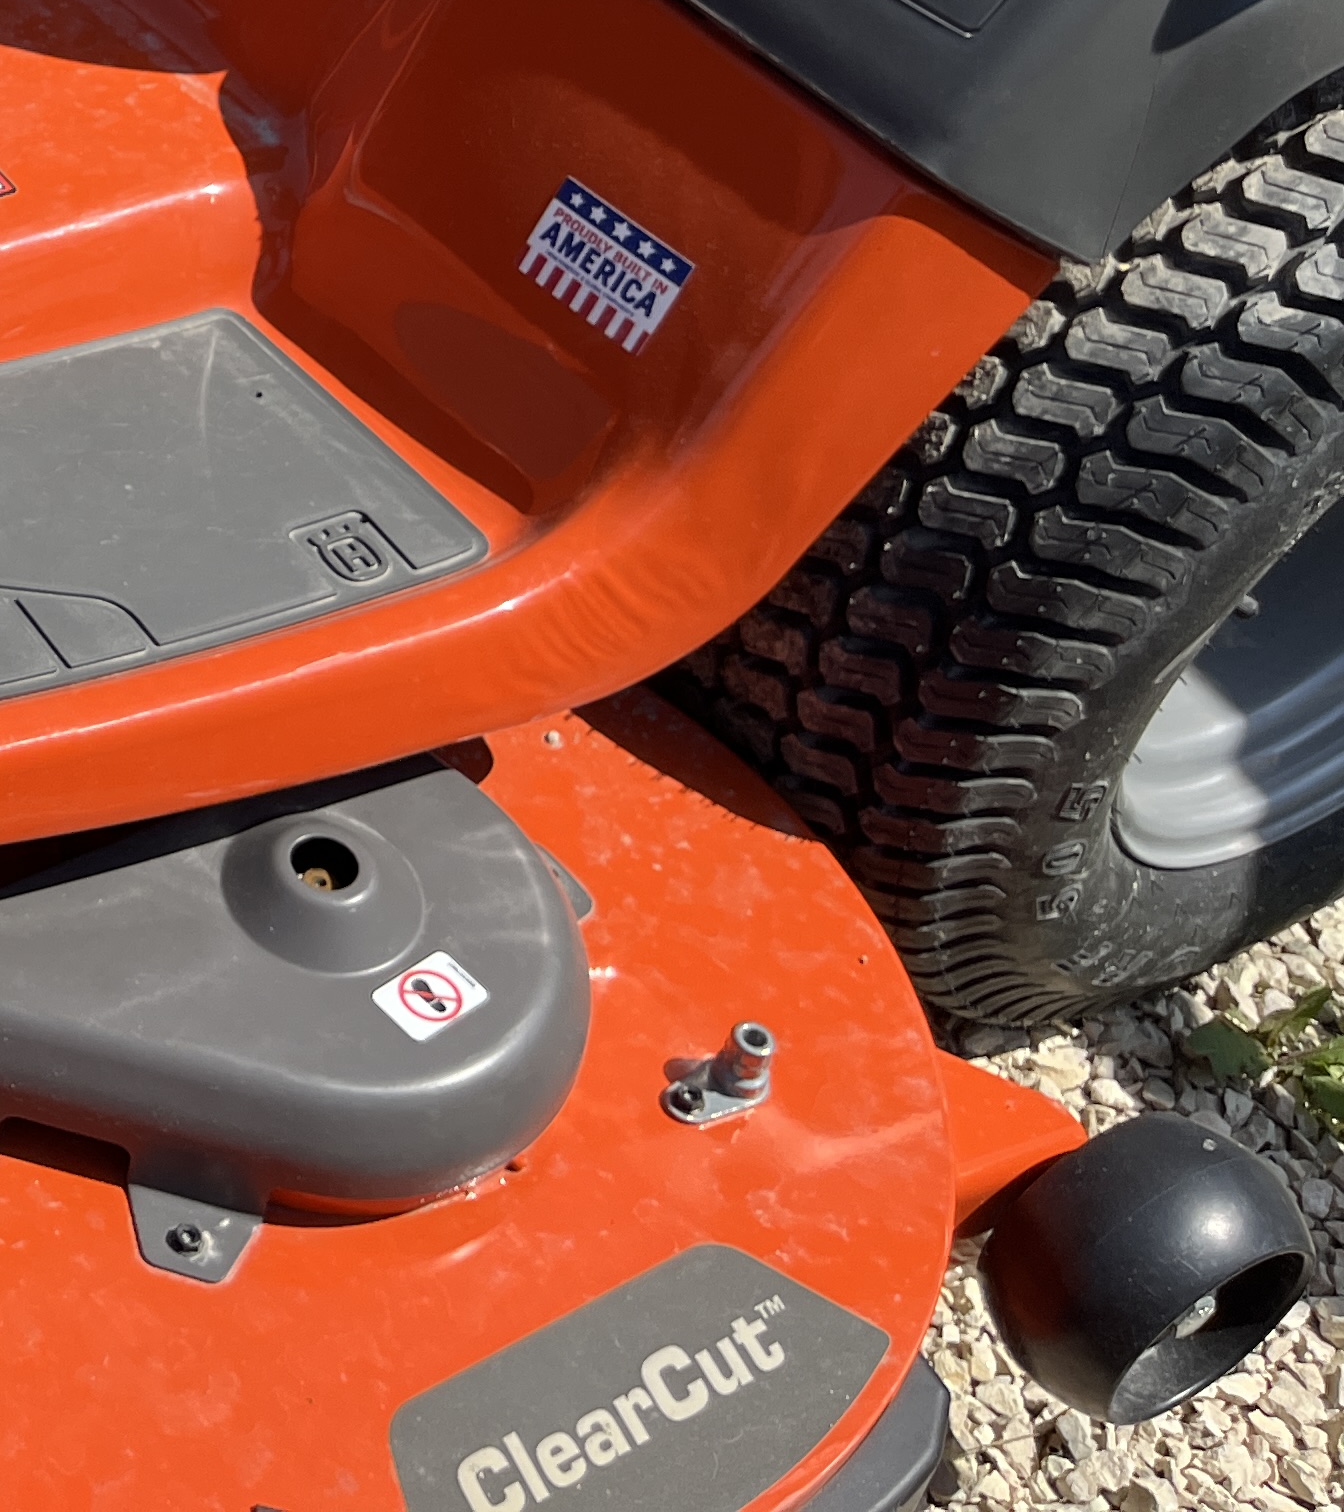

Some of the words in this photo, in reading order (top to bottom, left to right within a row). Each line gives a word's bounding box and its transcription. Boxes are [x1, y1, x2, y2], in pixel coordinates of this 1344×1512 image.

[540, 221, 657, 317] AMERICA
[553, 207, 613, 255] PROUDLY
[614, 250, 651, 282] BUILT
[650, 277, 668, 295] IN
[457, 1316, 786, 1512] ClearCut
